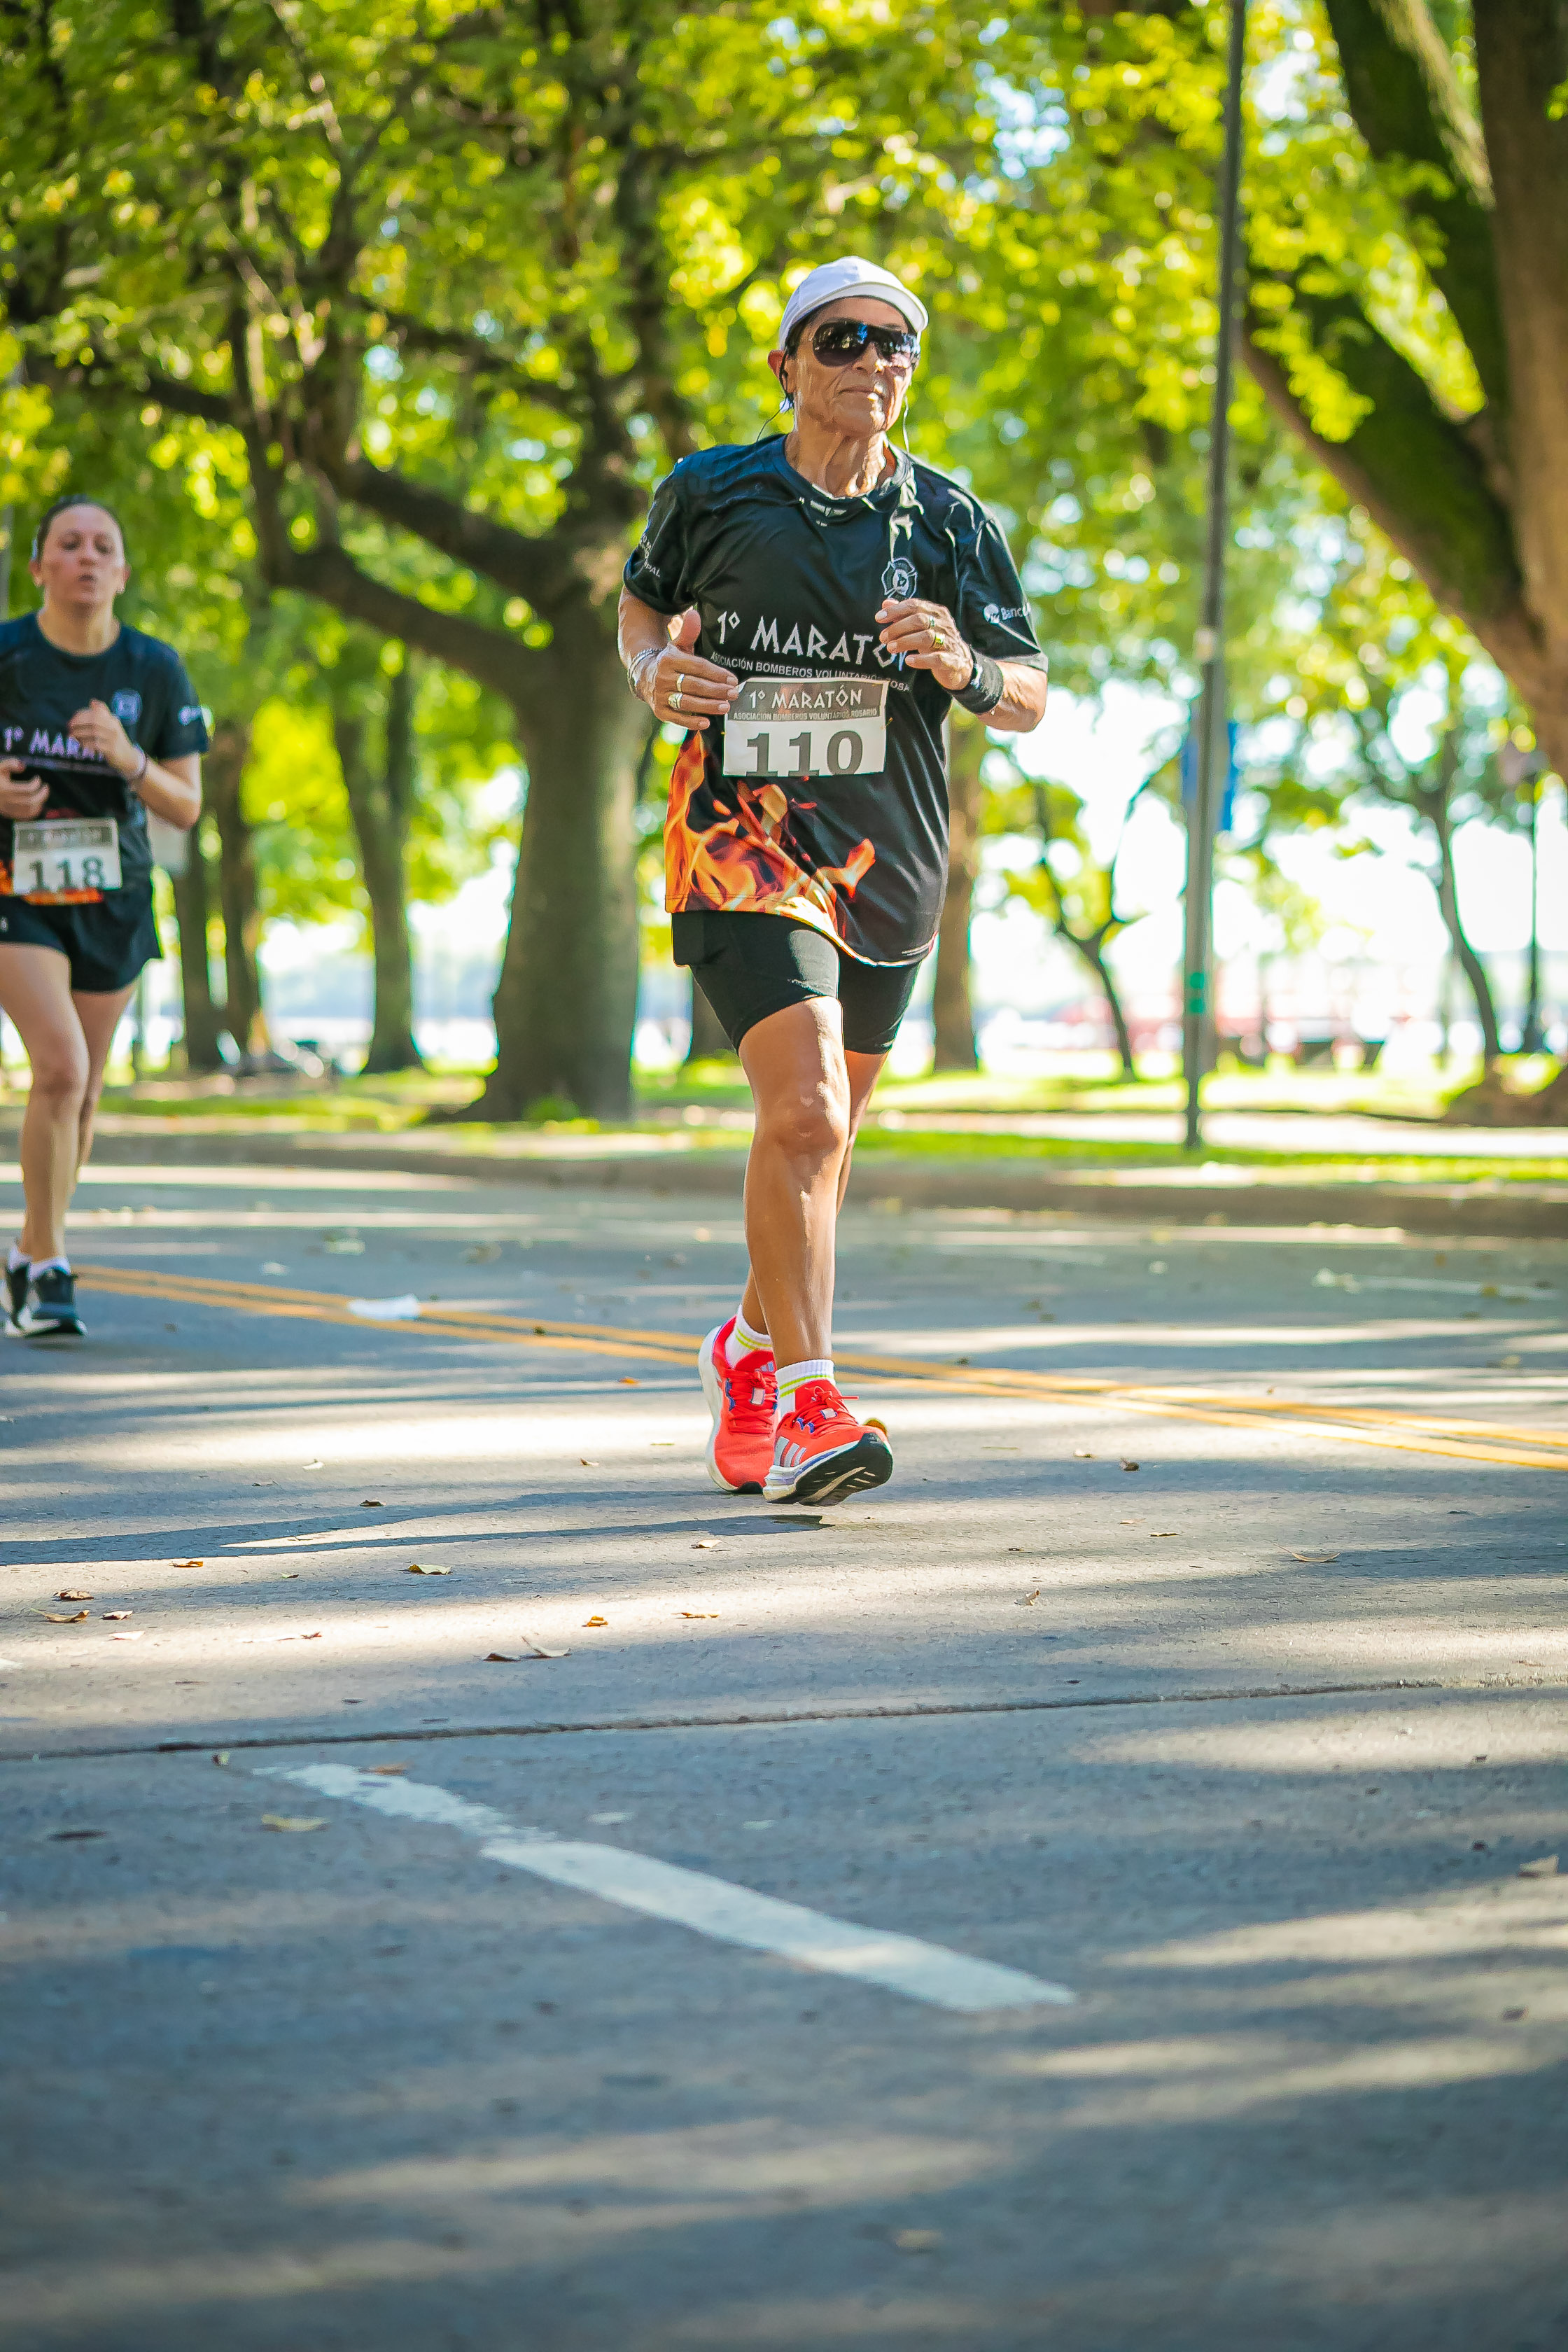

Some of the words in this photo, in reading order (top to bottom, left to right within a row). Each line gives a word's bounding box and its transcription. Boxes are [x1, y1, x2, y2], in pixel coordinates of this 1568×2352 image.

[756, 662, 813, 678] BOMBEROS
[771, 684, 862, 710] MARATÓN
[851, 708, 877, 718] ROSARIO
[746, 730, 862, 777] 110
[29, 855, 105, 891] 118
